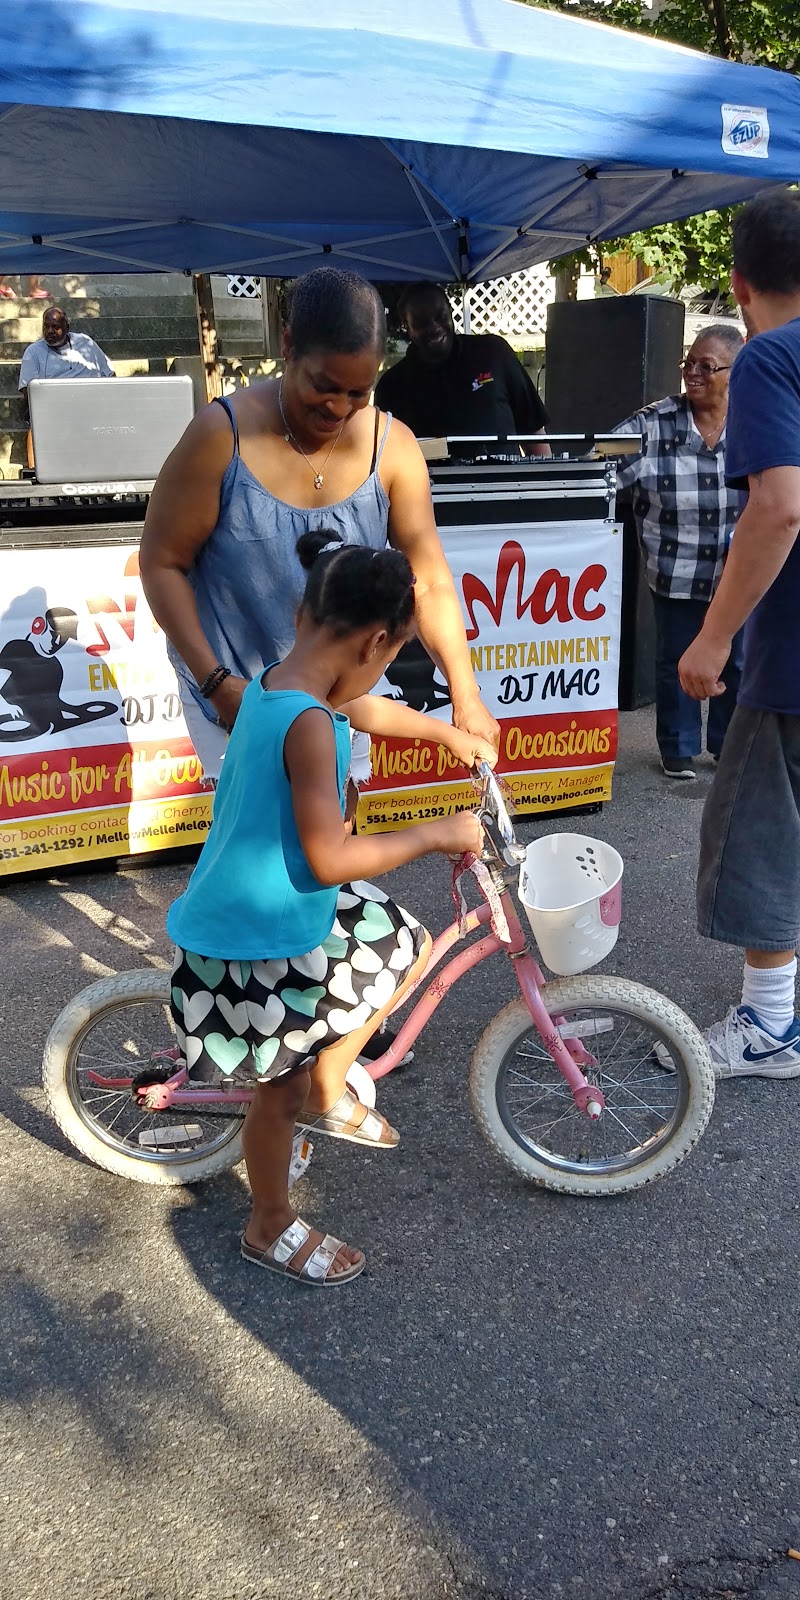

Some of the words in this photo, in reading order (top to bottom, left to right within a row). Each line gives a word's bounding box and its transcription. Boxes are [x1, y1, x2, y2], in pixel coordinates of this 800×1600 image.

[461, 540, 608, 642] Mac
[470, 636, 611, 672] NTERTAINMENT
[497, 672, 539, 705] DJ
[541, 668, 600, 701] MAC
[120, 693, 158, 727] DJ
[162, 692, 183, 723] D
[370, 738, 434, 779] Music
[437, 743, 459, 777] fo
[505, 720, 612, 761] Occasions
[69, 757, 110, 804] for
[154, 748, 204, 787] Occ
[368, 800, 388, 811] For
[390, 795, 439, 809] booking
[442, 789, 481, 802] contac
[511, 779, 554, 792] Cherry,
[558, 773, 605, 788] Manager
[20, 823, 77, 841] booking
[80, 816, 128, 832] contac
[163, 805, 210, 819] Cherry,
[96, 820, 213, 845] MellowMelleMel@y
[367, 807, 445, 824] 551-241-1292
